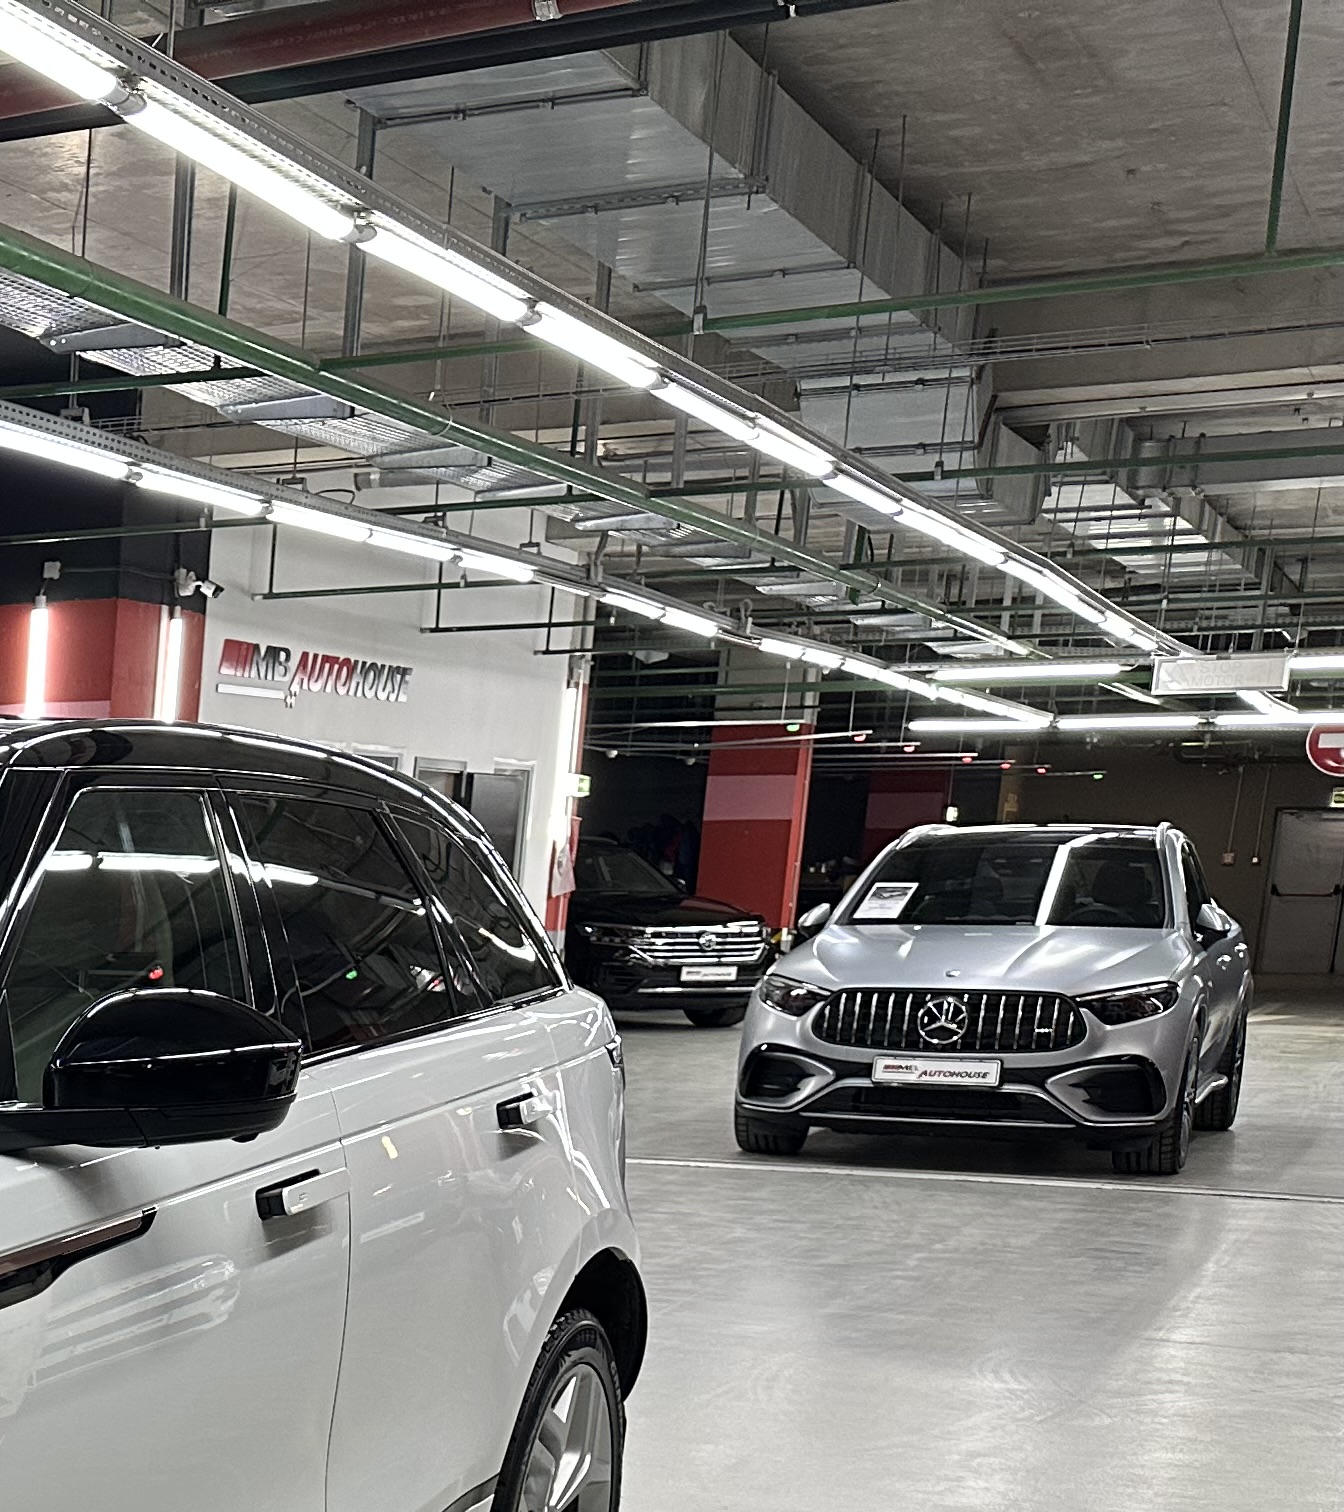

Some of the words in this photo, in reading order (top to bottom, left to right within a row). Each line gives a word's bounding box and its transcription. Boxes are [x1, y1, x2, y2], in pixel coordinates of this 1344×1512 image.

[1200, 661, 1243, 674] STOP
[290, 651, 414, 703] AUTOHOUSE
[1192, 673, 1244, 687] MOTOR
[918, 1069, 990, 1080] AUTOHOUSE
